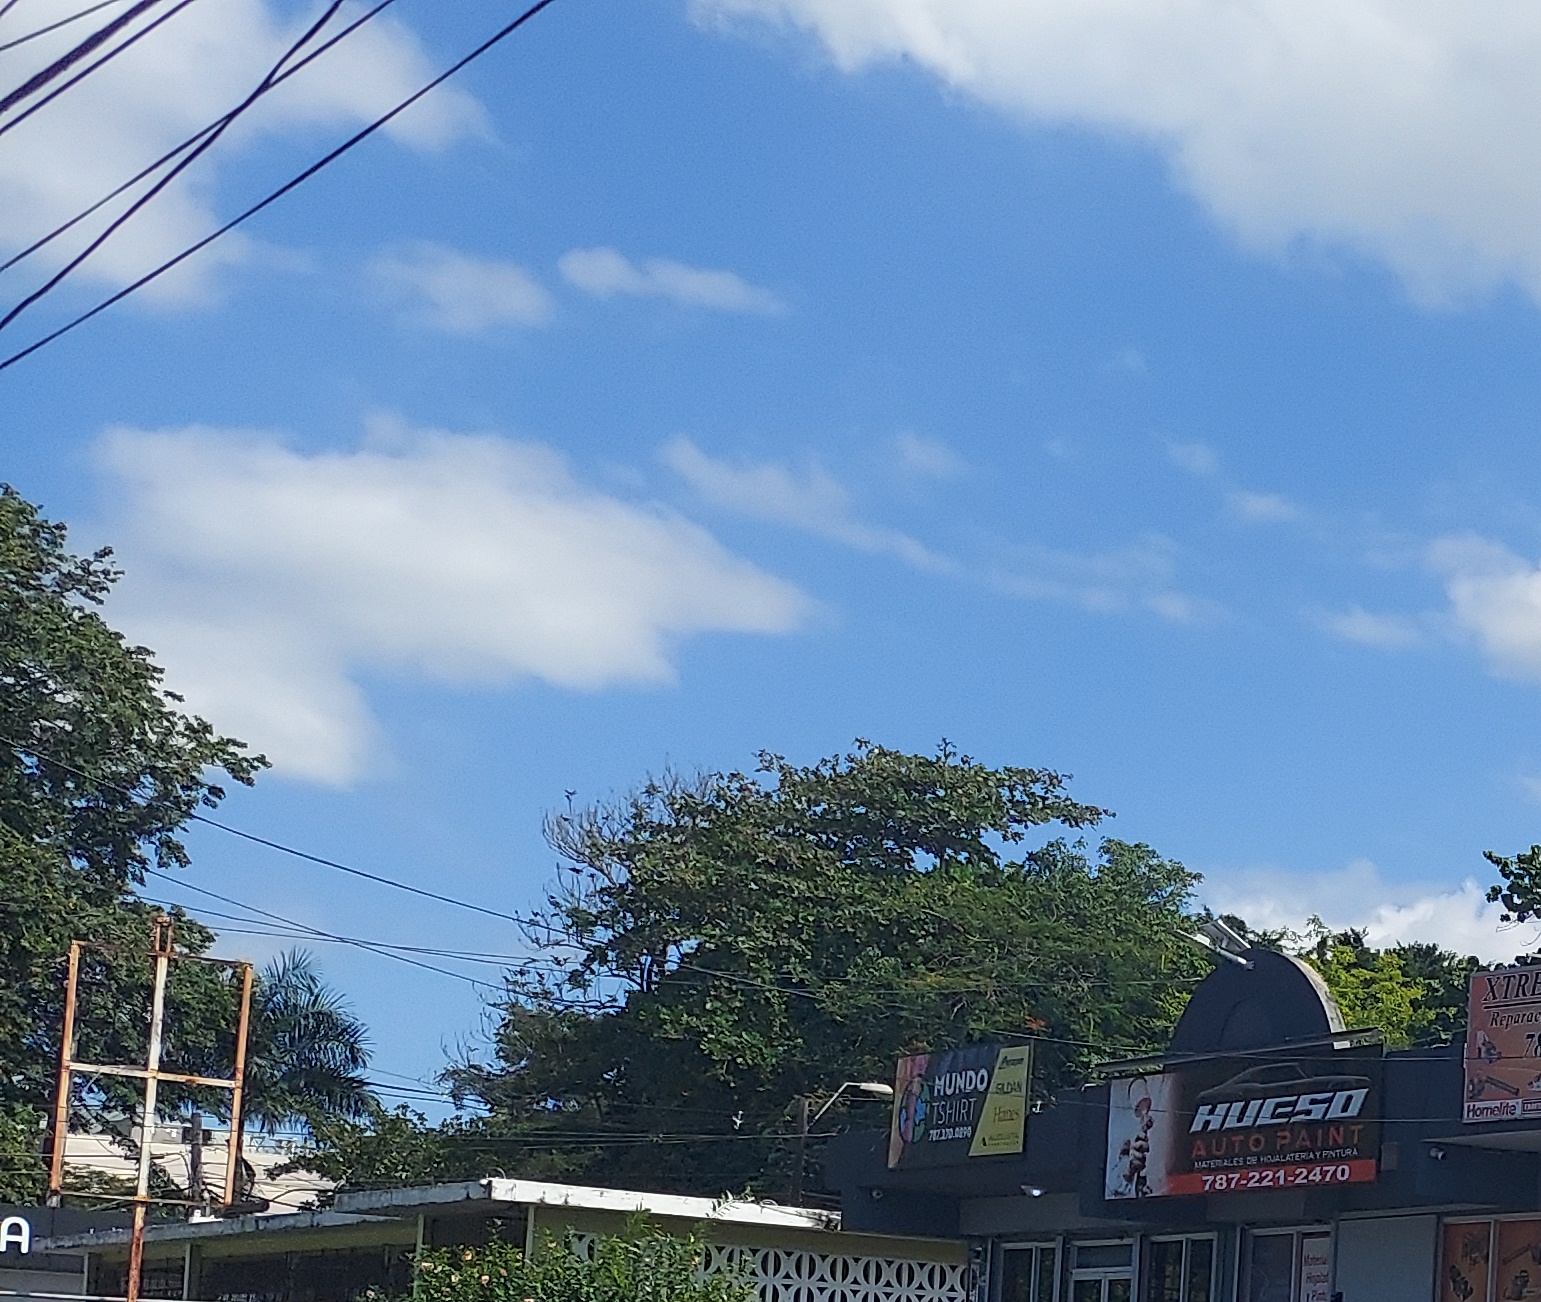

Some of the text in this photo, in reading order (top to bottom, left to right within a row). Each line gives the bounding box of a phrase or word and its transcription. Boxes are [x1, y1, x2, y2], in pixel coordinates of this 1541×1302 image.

[933, 1067, 989, 1097] MUNDO
[932, 1098, 977, 1125] TSHIRT
[1189, 1088, 1370, 1134] HUESO
[1466, 1101, 1517, 1118] Homelite
[1191, 1124, 1365, 1159] AUTO PAINT
[1202, 1164, 1350, 1191] 787-221-2470
[0, 1216, 30, 1254] A
